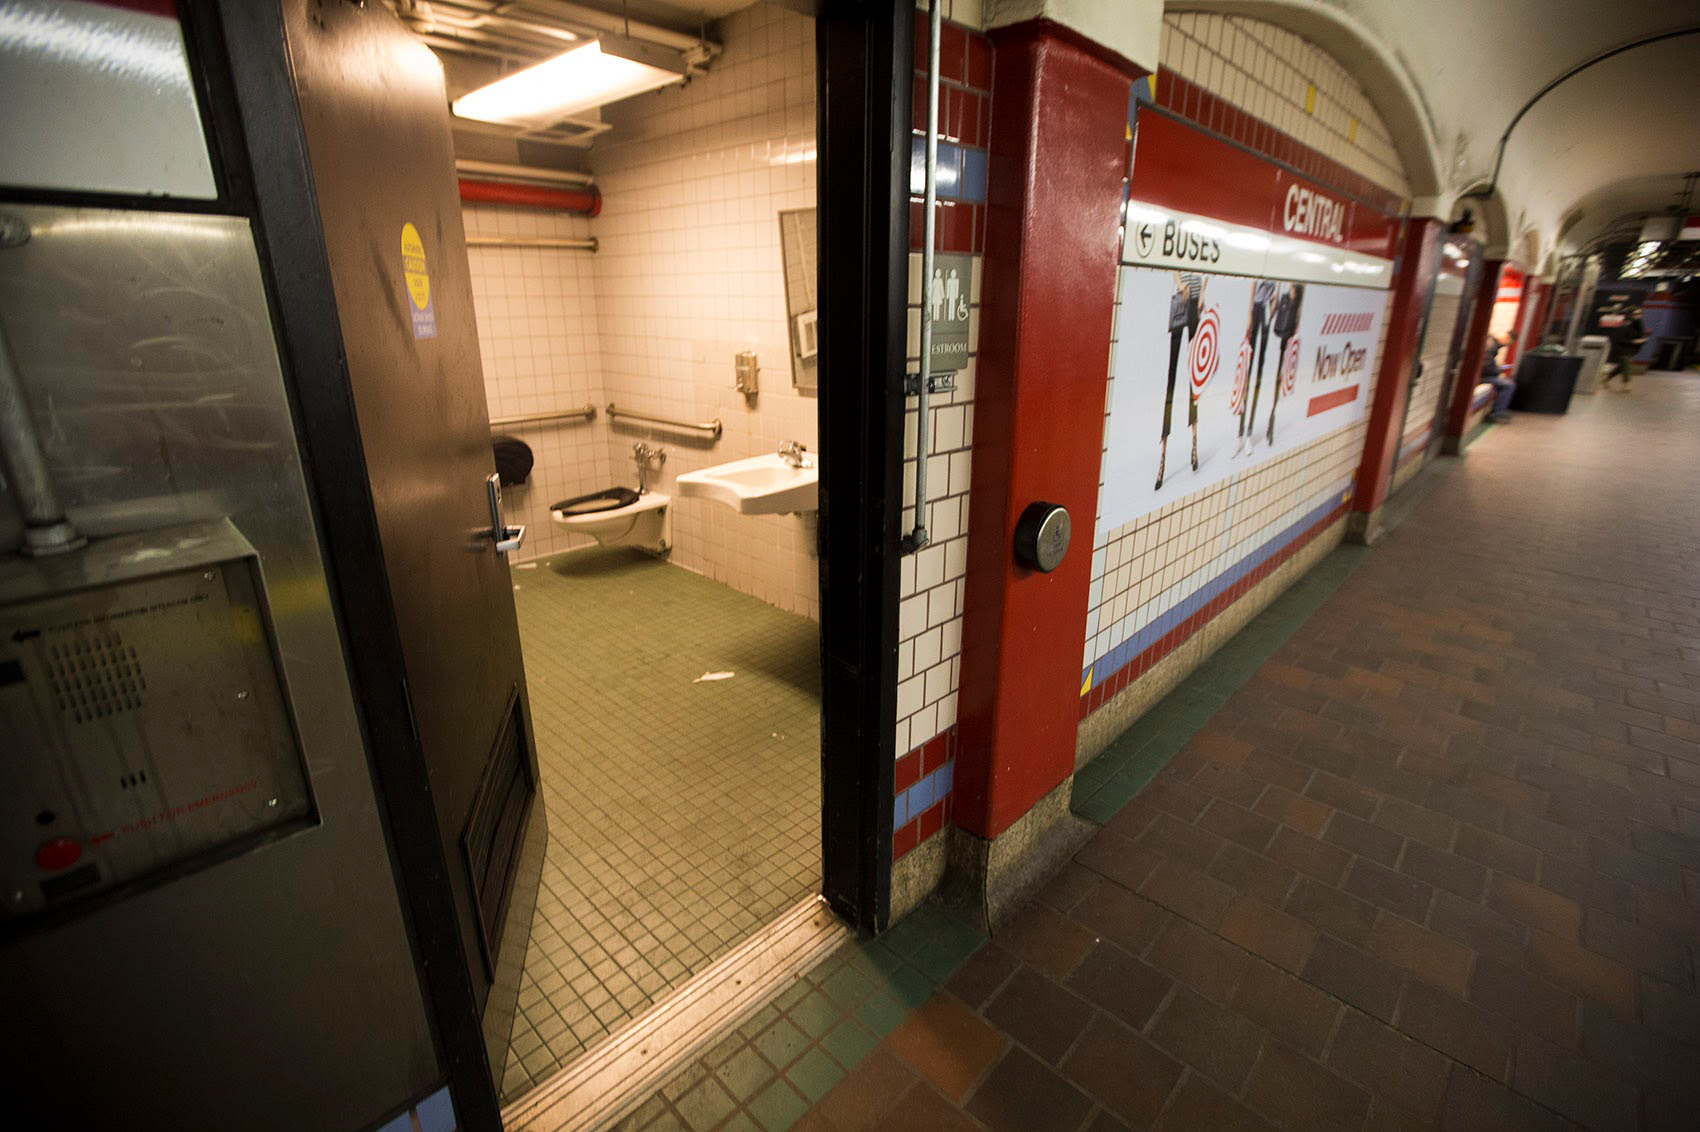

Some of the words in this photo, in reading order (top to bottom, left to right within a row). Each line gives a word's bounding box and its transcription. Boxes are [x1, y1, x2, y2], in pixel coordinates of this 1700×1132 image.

[1284, 183, 1345, 243] CENTRAL
[1162, 218, 1220, 263] BUSES
[931, 342, 967, 355] ESTROOM
[1312, 345, 1339, 384] Now
[1341, 341, 1367, 382] Open
